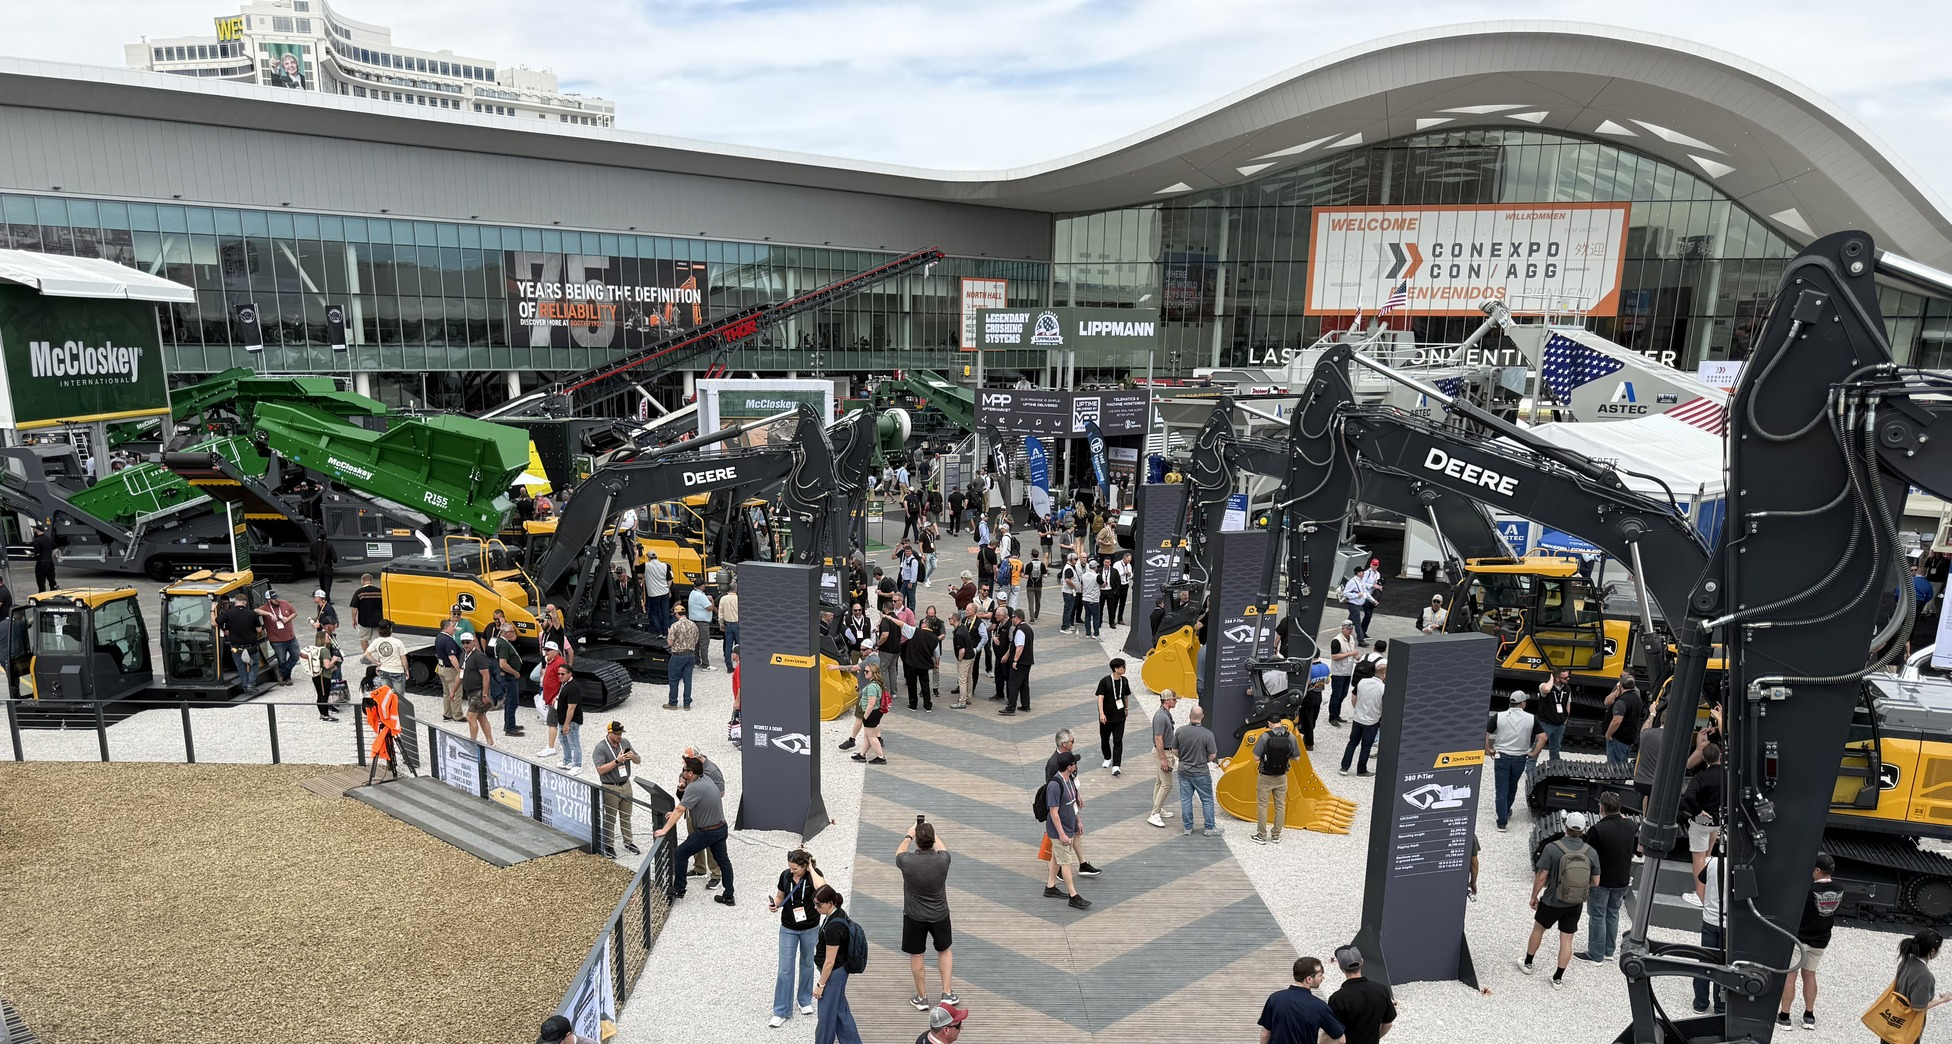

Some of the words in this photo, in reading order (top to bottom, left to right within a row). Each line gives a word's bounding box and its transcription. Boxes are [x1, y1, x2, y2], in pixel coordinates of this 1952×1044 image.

[1505, 212, 1567, 220] WILLKOMMEN
[1331, 218, 1419, 231] WELCOME
[1432, 242, 1560, 258] CONEXPO
[1166, 270, 1187, 278] WHERE
[1165, 280, 1176, 288] THE
[1177, 281, 1198, 289] WORLD
[516, 281, 562, 300] YEARS
[566, 283, 604, 301] BEING
[607, 285, 631, 301] THE
[635, 287, 701, 304] DEFINITION
[966, 291, 987, 299] NORTH
[1164, 291, 1180, 299] BUYS
[1184, 291, 1202, 299] SELLS
[1389, 286, 1506, 300] BENVENIDOS
[518, 302, 536, 319] OF
[540, 303, 617, 321] RELIABILITY
[1164, 301, 1197, 309] EQUIPMENT
[985, 313, 1030, 323] LEGENDARY
[723, 320, 758, 343] THOR
[985, 323, 1023, 333] CRUSHING
[1079, 321, 1154, 337] LIPPMANN
[985, 333, 1021, 343] SYSTEMS
[29, 341, 138, 382] McCloskey
[1249, 348, 1292, 364] LAS
[60, 378, 129, 387] INTERNATIONAL
[745, 399, 797, 409] McCloskey
[982, 393, 1012, 407] MPP
[1597, 403, 1647, 415] ASTEC
[994, 443, 1007, 475] MPP
[327, 457, 373, 480] McCloskey
[1423, 447, 1519, 497] DEERE
[682, 466, 738, 487] DEERE
[423, 491, 449, 506] R155
[1404, 774, 1416, 782] 380
